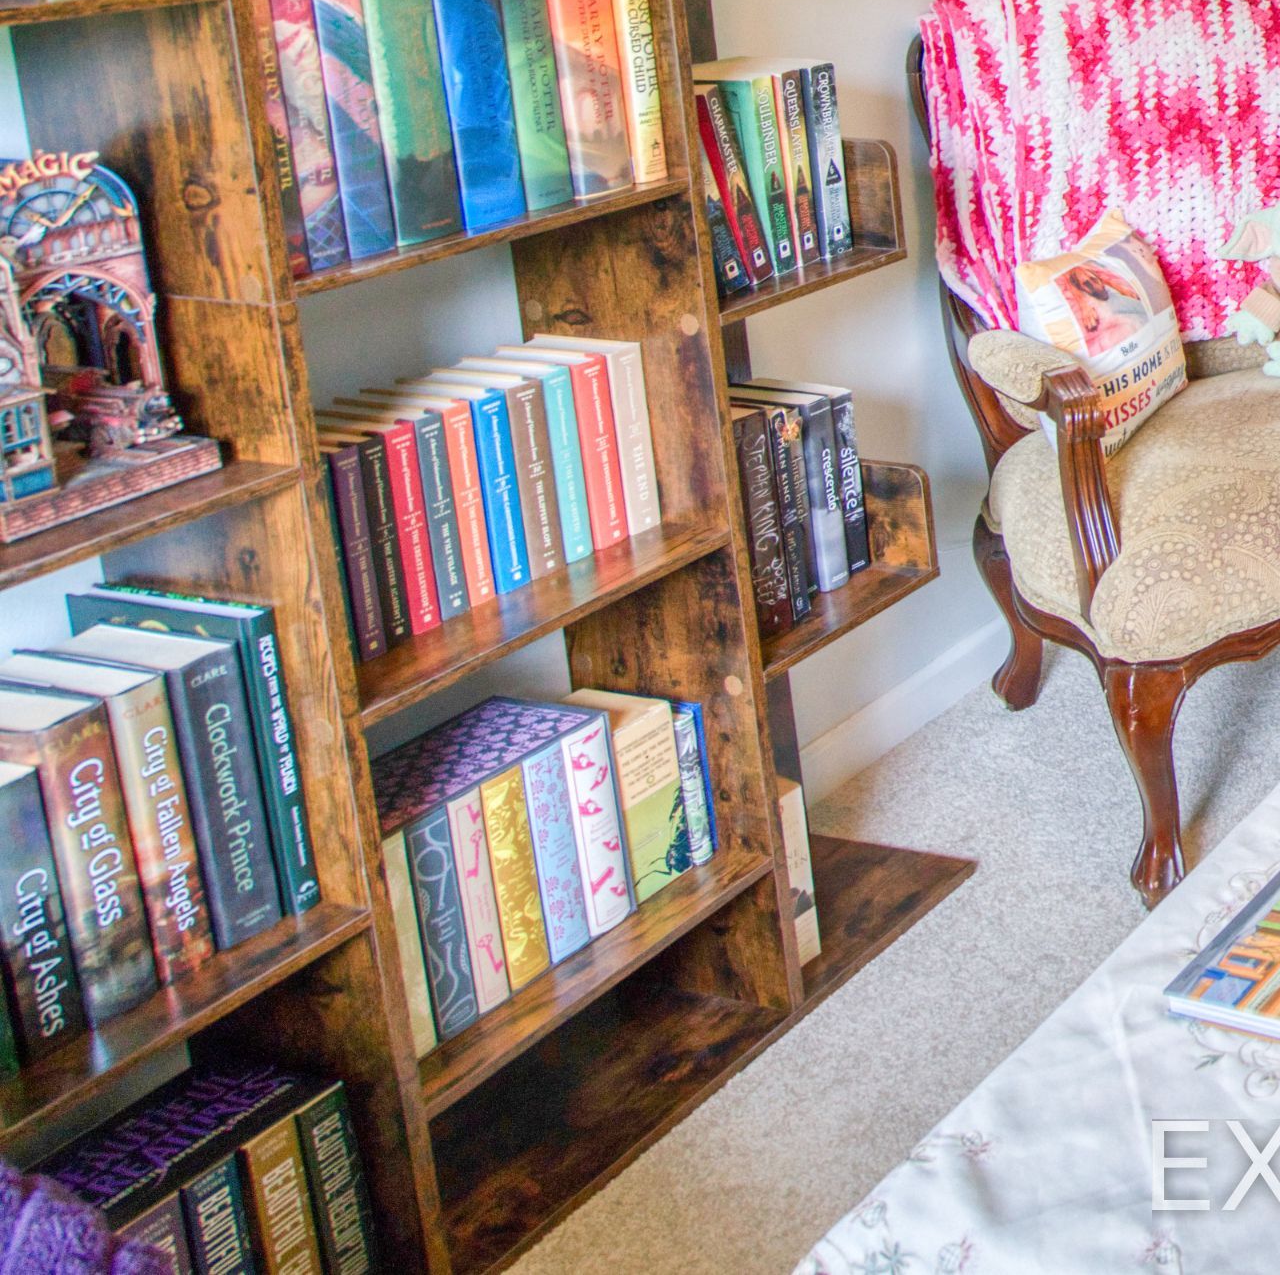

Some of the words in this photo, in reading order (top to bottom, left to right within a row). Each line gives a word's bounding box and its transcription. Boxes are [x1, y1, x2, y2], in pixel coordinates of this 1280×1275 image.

[626, 7, 642, 53] CURSED
[596, 55, 613, 121] POTTER
[632, 55, 646, 93] CHILD
[641, 32, 659, 99] POTTER
[538, 63, 556, 131] POTTER
[782, 77, 804, 162] QUEENSLAYER
[815, 70, 837, 159] CROWNBREAKER
[708, 96, 738, 176] CHARMCASTER
[754, 85, 778, 173] SOULBINDER
[0, 149, 99, 201] MAGIC
[1097, 373, 1129, 397] HIS
[1132, 350, 1162, 384] HOME
[1103, 387, 1152, 431] KISSES
[632, 443, 645, 470] THE
[744, 434, 770, 502] STEPHEN
[779, 470, 791, 503] KING
[822, 448, 837, 511] crescendo
[841, 446, 858, 510] silence
[636, 473, 649, 502] END
[442, 522, 450, 537] THE
[444, 537, 453, 554] VILE
[754, 501, 780, 552] KING
[447, 554, 458, 586] VILLAGE
[771, 557, 787, 601] DOCTOR
[190, 665, 228, 691] CLARE
[257, 632, 278, 678] RECIPES
[141, 726, 167, 784] City
[269, 706, 289, 746] WORLD
[67, 757, 104, 832] City
[204, 702, 244, 823] Clockwork
[227, 816, 255, 895] Prince
[276, 751, 297, 796] TOLKIEN
[86, 813, 109, 844] of
[156, 792, 184, 863] Fallen
[13, 867, 47, 936] City
[87, 843, 123, 929] Glass
[165, 859, 195, 933] Angels
[31, 931, 58, 956] of
[29, 956, 67, 1038] Ashes
[312, 1112, 351, 1201] BEAUTIFUL
[197, 1185, 246, 1275] BEAUTIFU
[261, 1156, 308, 1264] BEAUTIFUL
